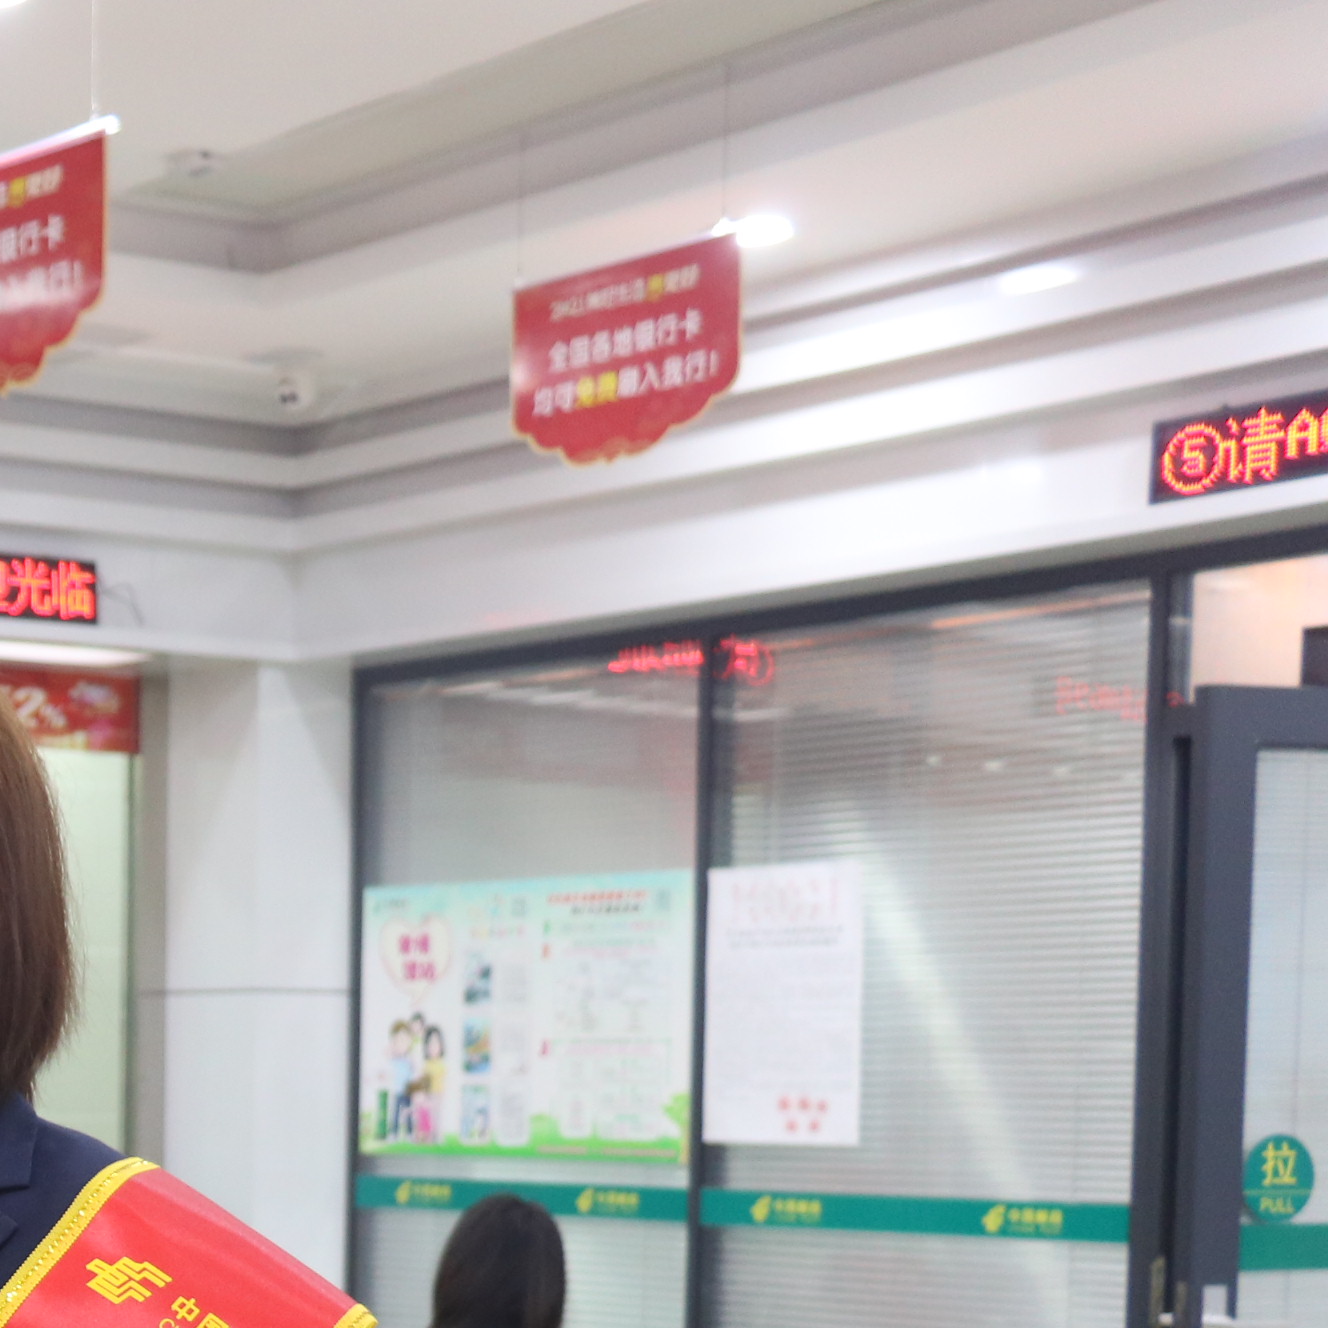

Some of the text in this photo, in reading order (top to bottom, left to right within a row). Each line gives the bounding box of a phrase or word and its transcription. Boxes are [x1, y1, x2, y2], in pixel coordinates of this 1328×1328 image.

[1161, 406, 1328, 496] ⑤请A
[1261, 1141, 1297, 1187] 拉
[1260, 1196, 1297, 1214] PULL
